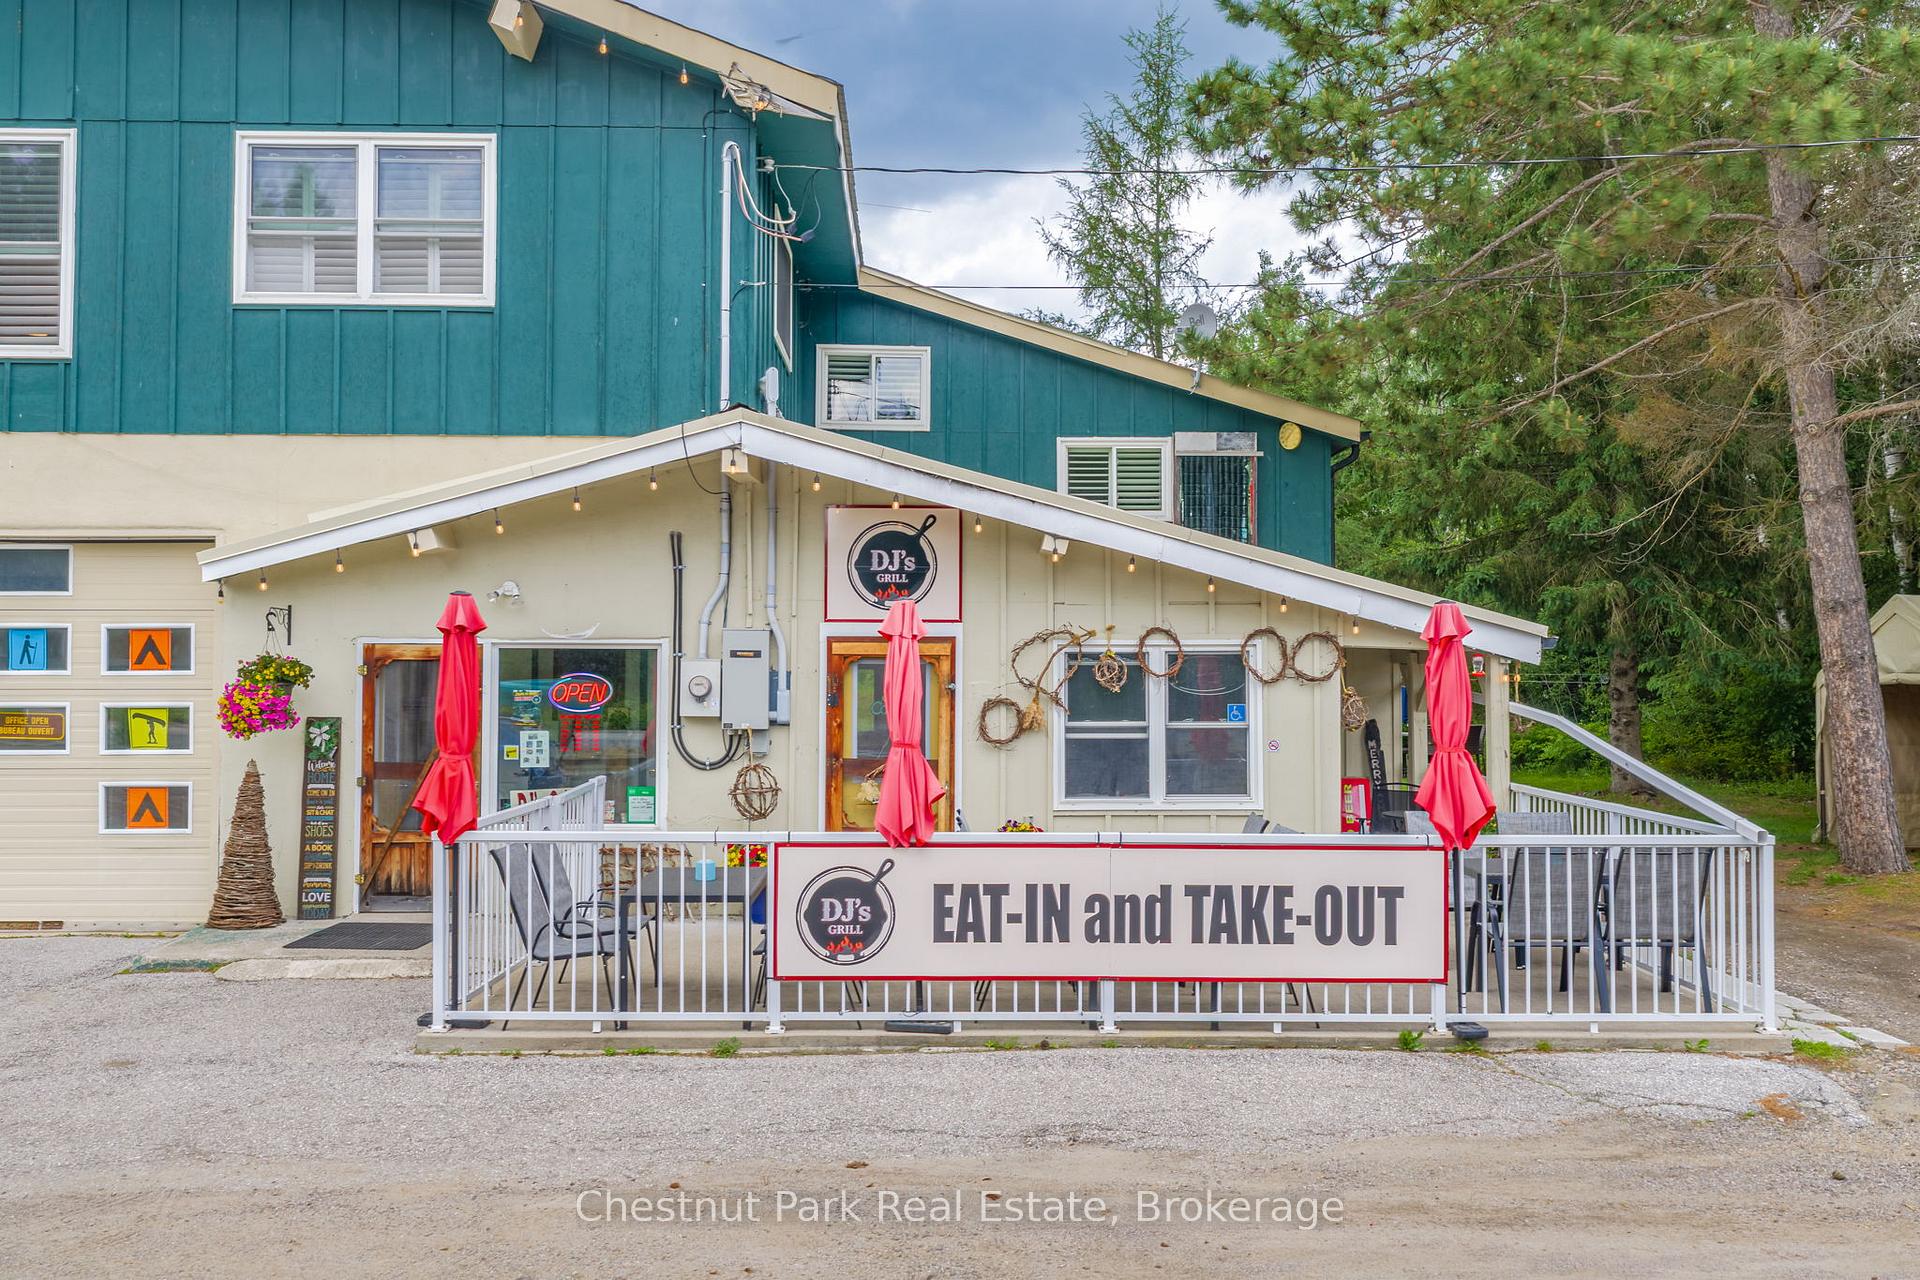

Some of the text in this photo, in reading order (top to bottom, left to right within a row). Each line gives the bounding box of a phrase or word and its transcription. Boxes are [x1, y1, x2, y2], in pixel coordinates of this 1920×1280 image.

[870, 549, 916, 571] DJ's
[876, 573, 909, 583] GRILL
[552, 682, 608, 703] OPEN
[5, 716, 49, 725] OFFICE OPEN
[28, 727, 54, 736] OUVERT
[307, 772, 335, 784] HOME
[1344, 783, 1355, 824] BEER
[305, 825, 334, 837] SHOES
[311, 844, 333, 852] BOOK
[302, 892, 332, 902] LOVE
[820, 898, 872, 922] DJ's
[933, 884, 1404, 946] EAT-IN and TAKE-OUT
[828, 925, 863, 935] GRILL
